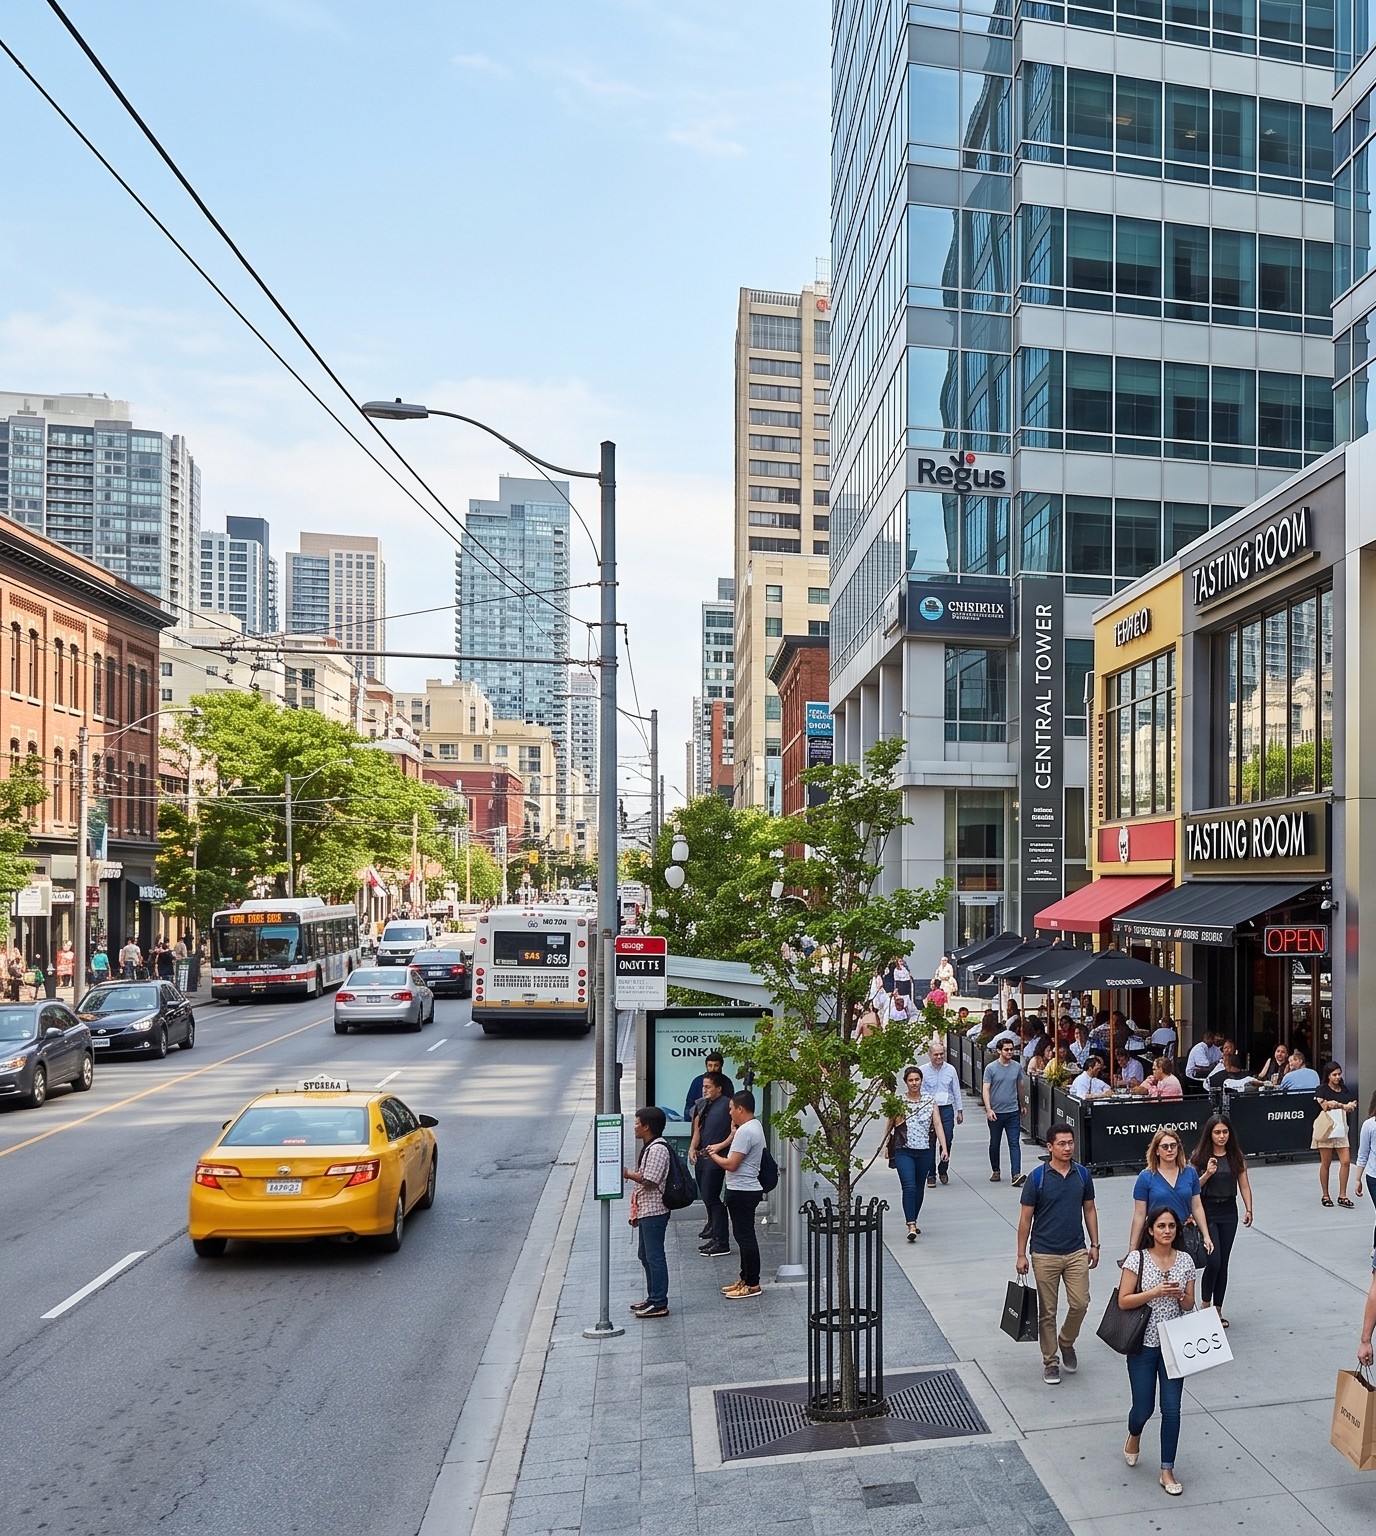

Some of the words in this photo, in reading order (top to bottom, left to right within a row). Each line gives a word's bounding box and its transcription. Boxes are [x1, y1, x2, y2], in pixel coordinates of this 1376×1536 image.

[917, 454, 1006, 494] Regus
[1192, 541, 1250, 605] TASTING
[1254, 507, 1311, 573] ROOM
[1035, 604, 1052, 684] TOWER
[1035, 689, 1052, 789] CENTRAL
[1186, 819, 1247, 860] TASTING
[1252, 811, 1306, 858] ROOM
[1267, 928, 1325, 952] OPEN
[1182, 1333, 1222, 1359] COS
